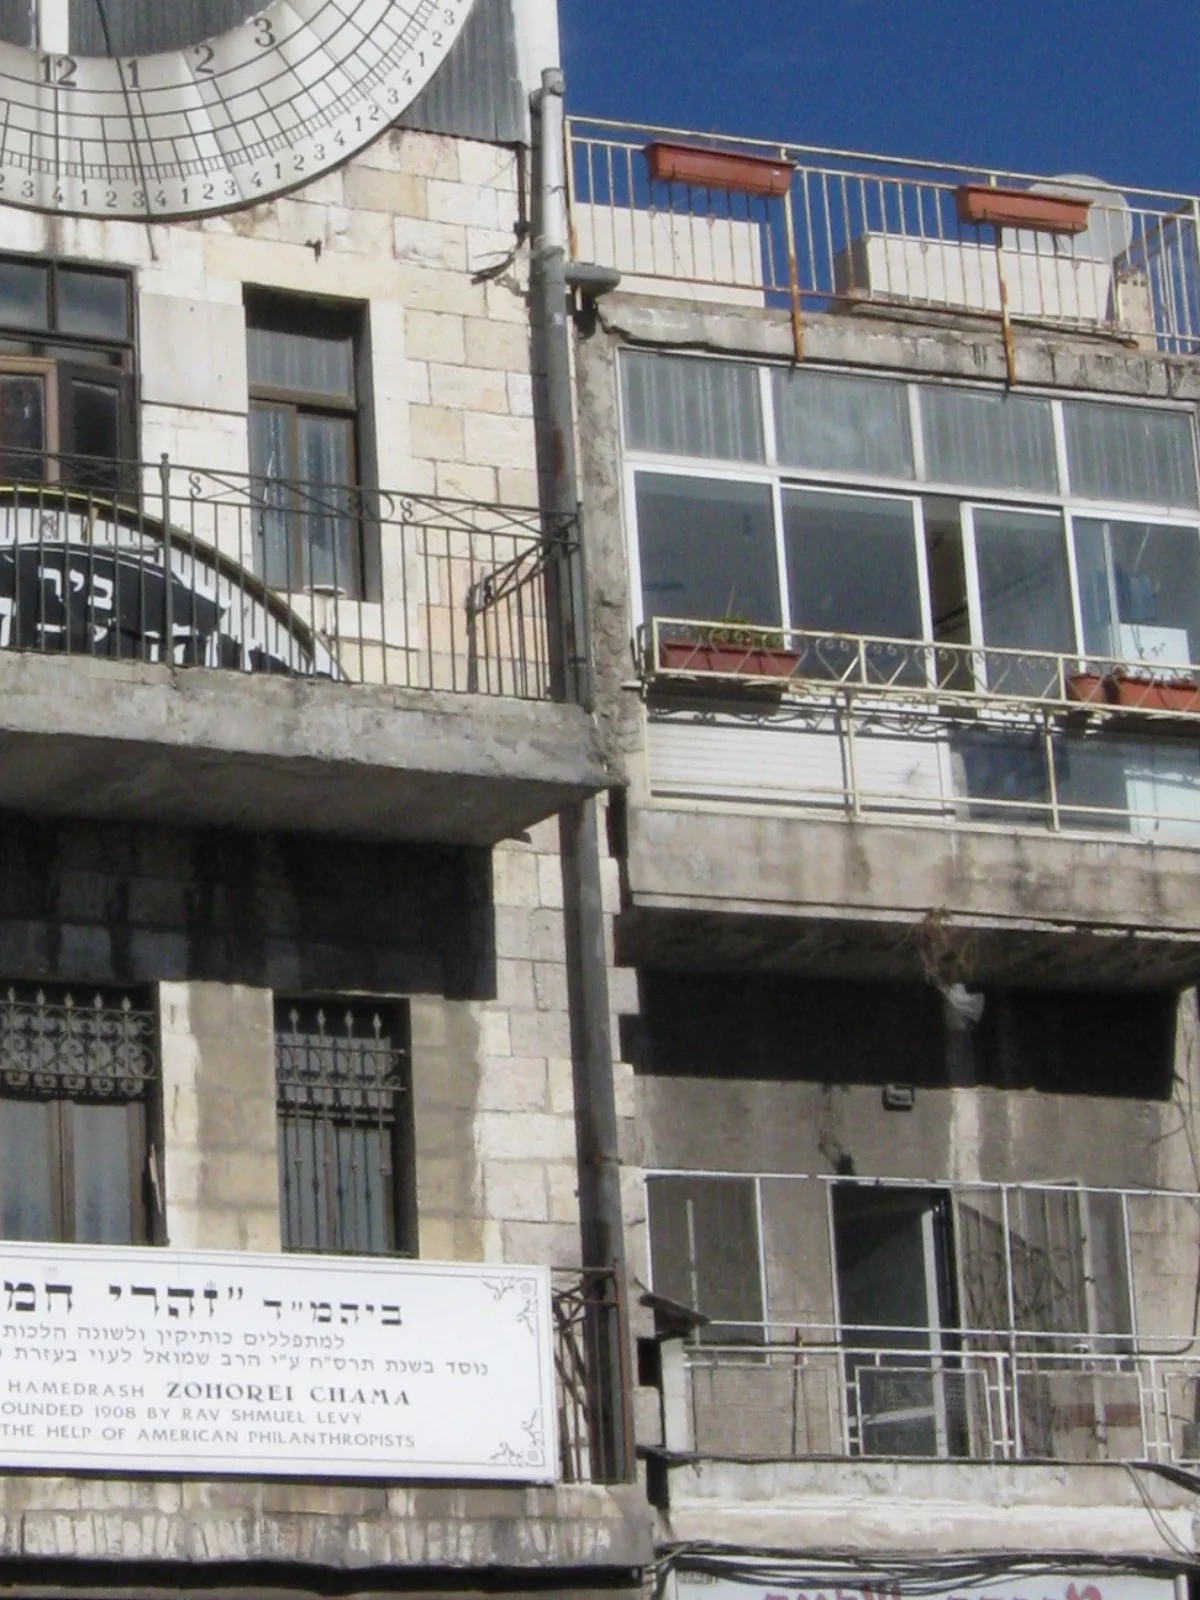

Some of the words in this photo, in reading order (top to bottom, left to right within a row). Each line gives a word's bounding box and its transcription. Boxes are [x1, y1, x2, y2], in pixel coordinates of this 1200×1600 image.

[39, 54, 78, 88] 12
[127, 59, 141, 88] 1
[195, 45, 214, 74] 2
[254, 17, 276, 47] 3
[20, 179, 35, 198] 3
[52, 185, 64, 203] 4
[82, 188, 89, 206] 1
[105, 190, 118, 208] 2
[132, 190, 146, 208] 3
[155, 190, 168, 207] 4
[181, 187, 189, 205] 1
[202, 182, 216, 200] 2
[224, 178, 237, 197] 3
[250, 170, 263, 188] 4
[274, 161, 282, 180] 1
[293, 153, 305, 171] 2
[314, 143, 326, 161] 3
[334, 129, 346, 146] 4
[355, 115, 362, 132] 1
[368, 104, 380, 121] 2
[387, 87, 400, 105] 3
[401, 69, 413, 86] 4
[418, 50, 426, 68] 1
[431, 30, 443, 48] 2
[443, 8, 456, 26] 3
[3, 1323, 67, 1340] הלכות
[77, 1325, 146, 1342] ולשונה
[156, 1329, 233, 1347] כותיקין
[243, 1331, 345, 1349] למתפללים
[14, 1346, 77, 1363] בעזרת
[89, 1347, 132, 1365] לעוי
[143, 1347, 210, 1366] שמואל
[220, 1353, 261, 1367] הרב
[385, 1359, 435, 1374] בשנת
[445, 1361, 489, 1376] נוסד
[8, 1379, 144, 1398] HAMEDRASH
[166, 1381, 293, 1403] ZOHOREI
[309, 1386, 410, 1406] CHAMA
[95, 1406, 137, 1419] 1908
[147, 1407, 170, 1420] BY
[182, 1407, 220, 1421] RAV
[231, 1409, 305, 1423] SHMUEL
[317, 1411, 362, 1425] LEVY
[1, 1423, 35, 1437] THE
[46, 1425, 92, 1439] HELP
[101, 1426, 126, 1441] OF
[137, 1428, 238, 1443] AMERICAN
[248, 1430, 416, 1448] PHILANTHROPISTS
